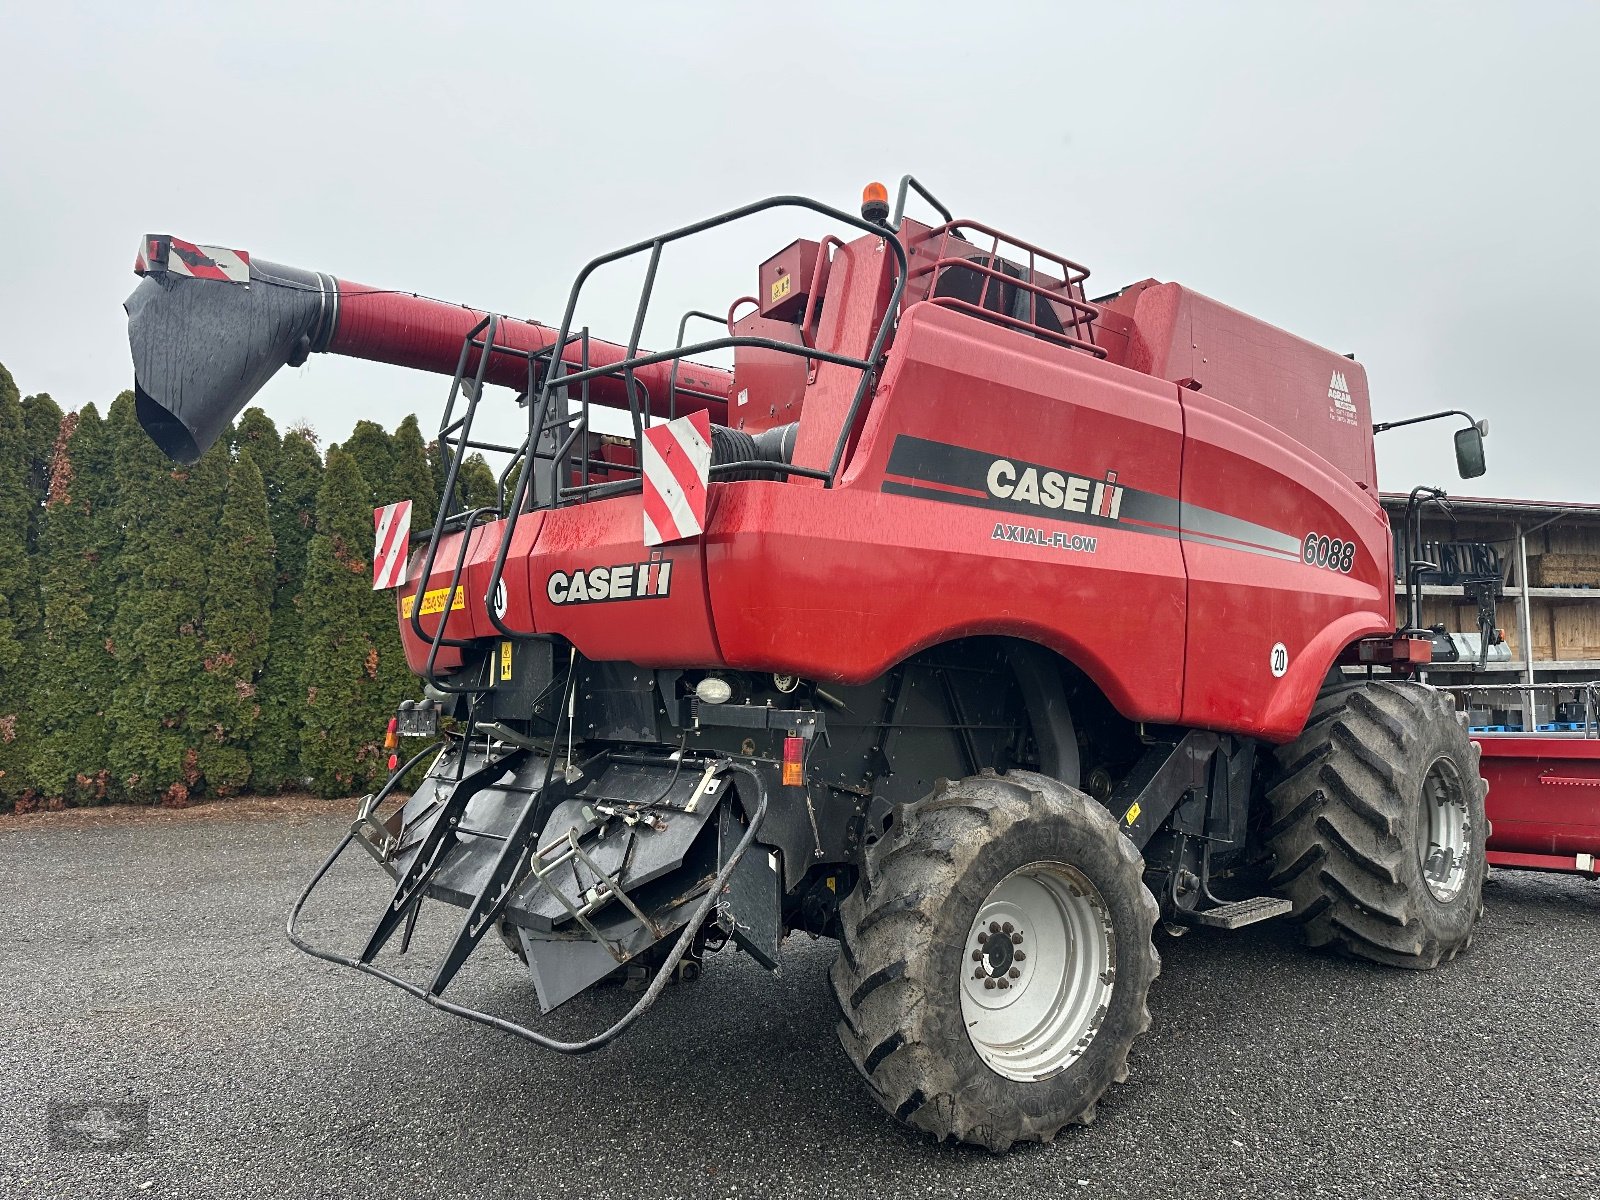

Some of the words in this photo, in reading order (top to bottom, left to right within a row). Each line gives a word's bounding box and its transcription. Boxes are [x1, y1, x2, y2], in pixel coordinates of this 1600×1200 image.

[1328, 389, 1351, 403] AGRAM
[987, 459, 1090, 514] CASE
[991, 523, 1097, 553] AXIAL-FLOW
[1302, 532, 1356, 574] 6088
[549, 566, 633, 604] CASE
[1274, 648, 1285, 672] 20
